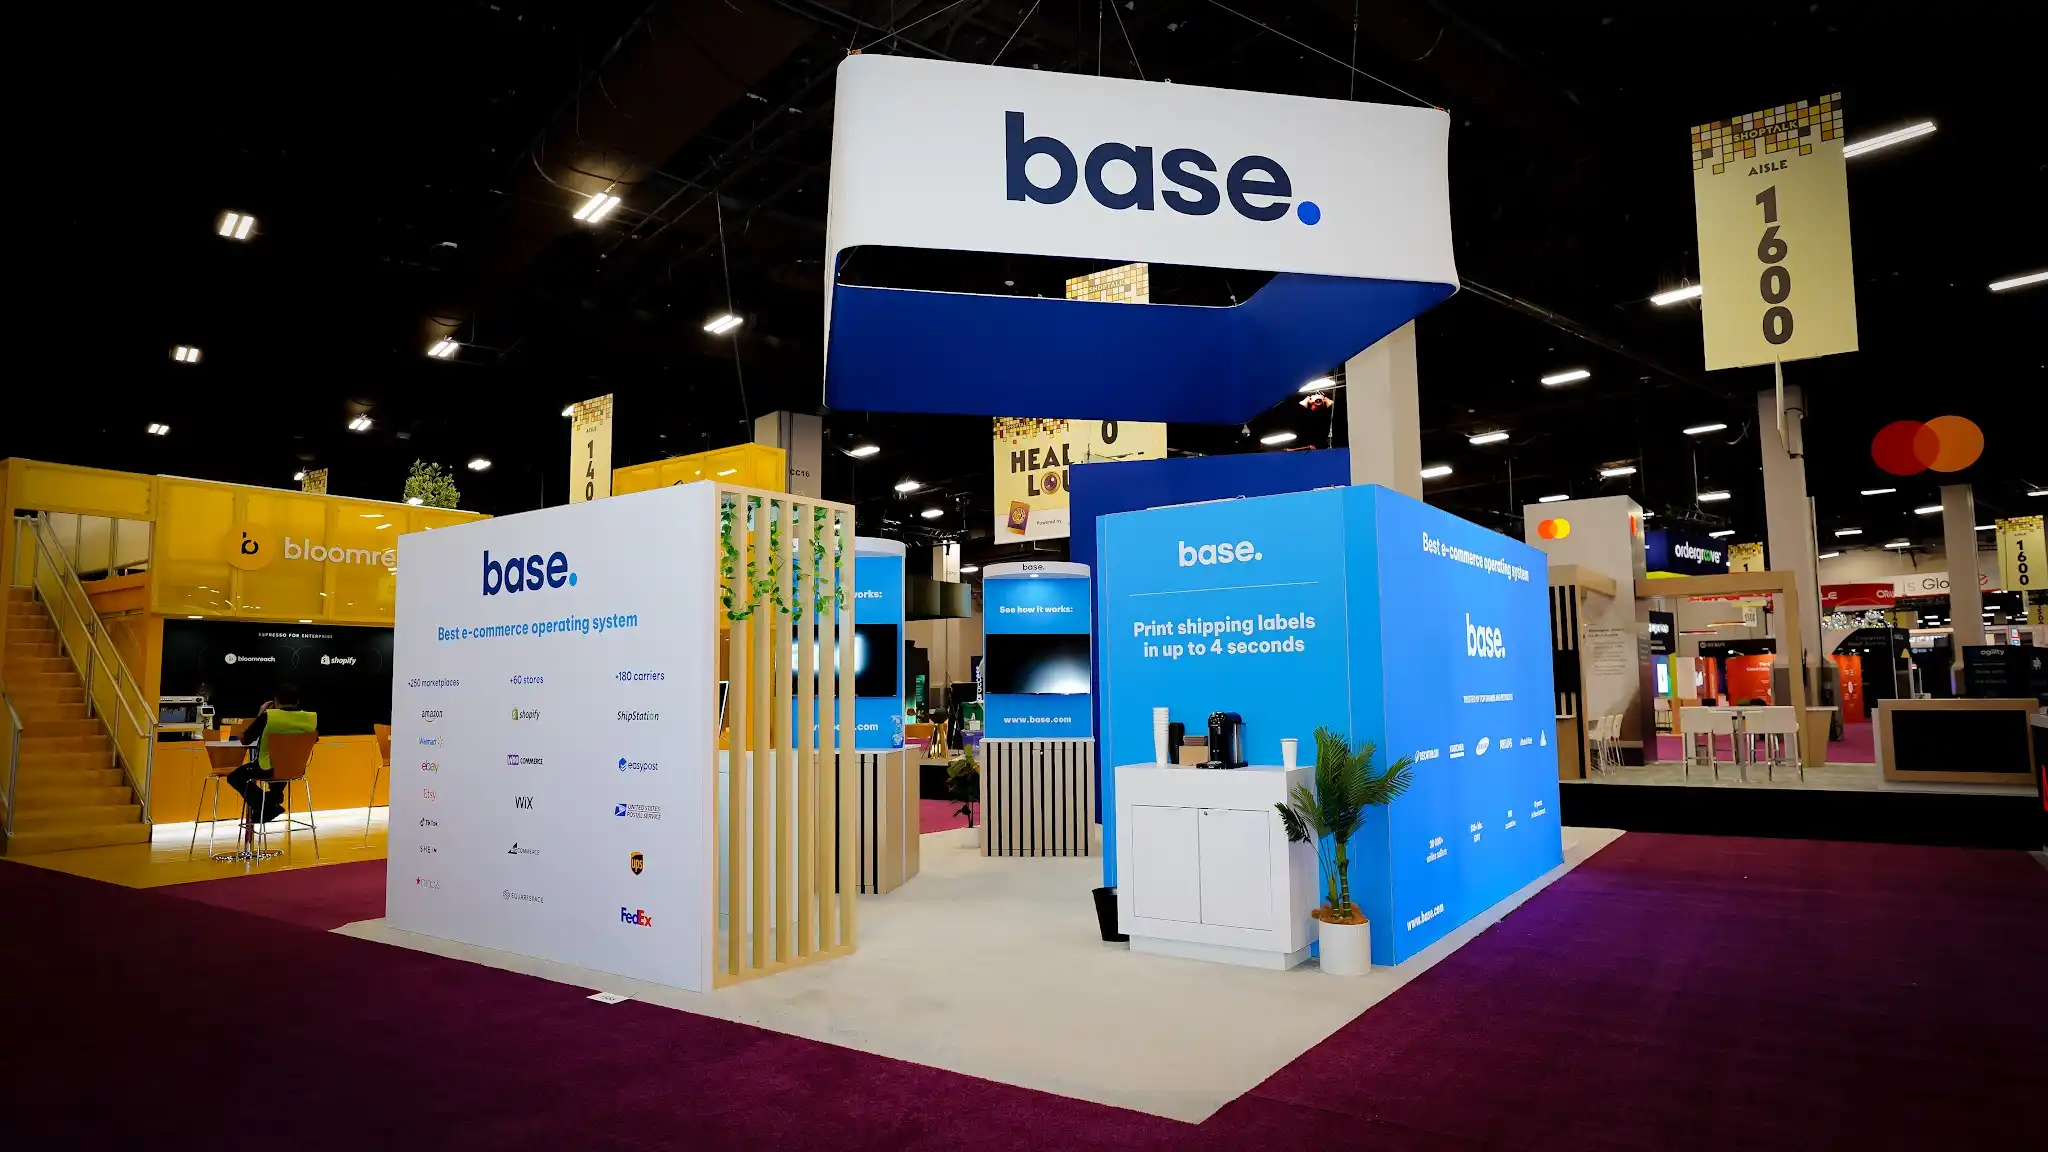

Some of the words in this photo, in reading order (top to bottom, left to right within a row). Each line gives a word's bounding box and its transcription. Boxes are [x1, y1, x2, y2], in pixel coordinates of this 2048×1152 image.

[1733, 120, 1797, 142] SHOPTALK
[1005, 111, 1321, 225] base.
[1748, 159, 1788, 176] AISLE
[1756, 185, 1794, 345] 1600
[1089, 280, 1125, 293] SHOPTALK
[1178, 540, 1263, 567] base.
[1422, 532, 1441, 556] Best
[1441, 543, 1483, 569] e-commerce
[1484, 557, 1512, 580] operating
[1022, 563, 1045, 571] base.
[2016, 540, 2029, 586] 1600
[483, 550, 577, 596] base.
[999, 606, 1016, 614] See
[1017, 606, 1035, 614] how
[1036, 606, 1043, 614] it
[1044, 606, 1073, 614] works:
[438, 626, 460, 641] Best
[461, 623, 529, 639] e-commerce
[531, 615, 590, 638] operating
[592, 612, 638, 632] system
[1133, 620, 1174, 637] Print
[1177, 616, 1253, 637] shipping
[1258, 612, 1316, 631] labels
[1465, 613, 1506, 659] base.
[1143, 642, 1159, 658] in
[1162, 644, 1184, 660] up
[1188, 641, 1206, 656] to
[1209, 638, 1223, 654] 4
[1227, 636, 1305, 655] seconds
[237, 655, 276, 663] bloomreach
[330, 656, 357, 665] shopify
[509, 675, 522, 684] +60
[523, 676, 544, 684] stores
[633, 670, 665, 681] carriers
[407, 679, 421, 688] +250
[421, 678, 460, 689] marketplaces
[421, 710, 443, 718] amazon
[519, 708, 541, 721] shopify
[617, 710, 660, 722] ShipStation
[1003, 715, 1072, 724] www.base.com
[628, 762, 659, 773] easypost
[631, 859, 643, 872] ups
[621, 907, 652, 927] FedEx
